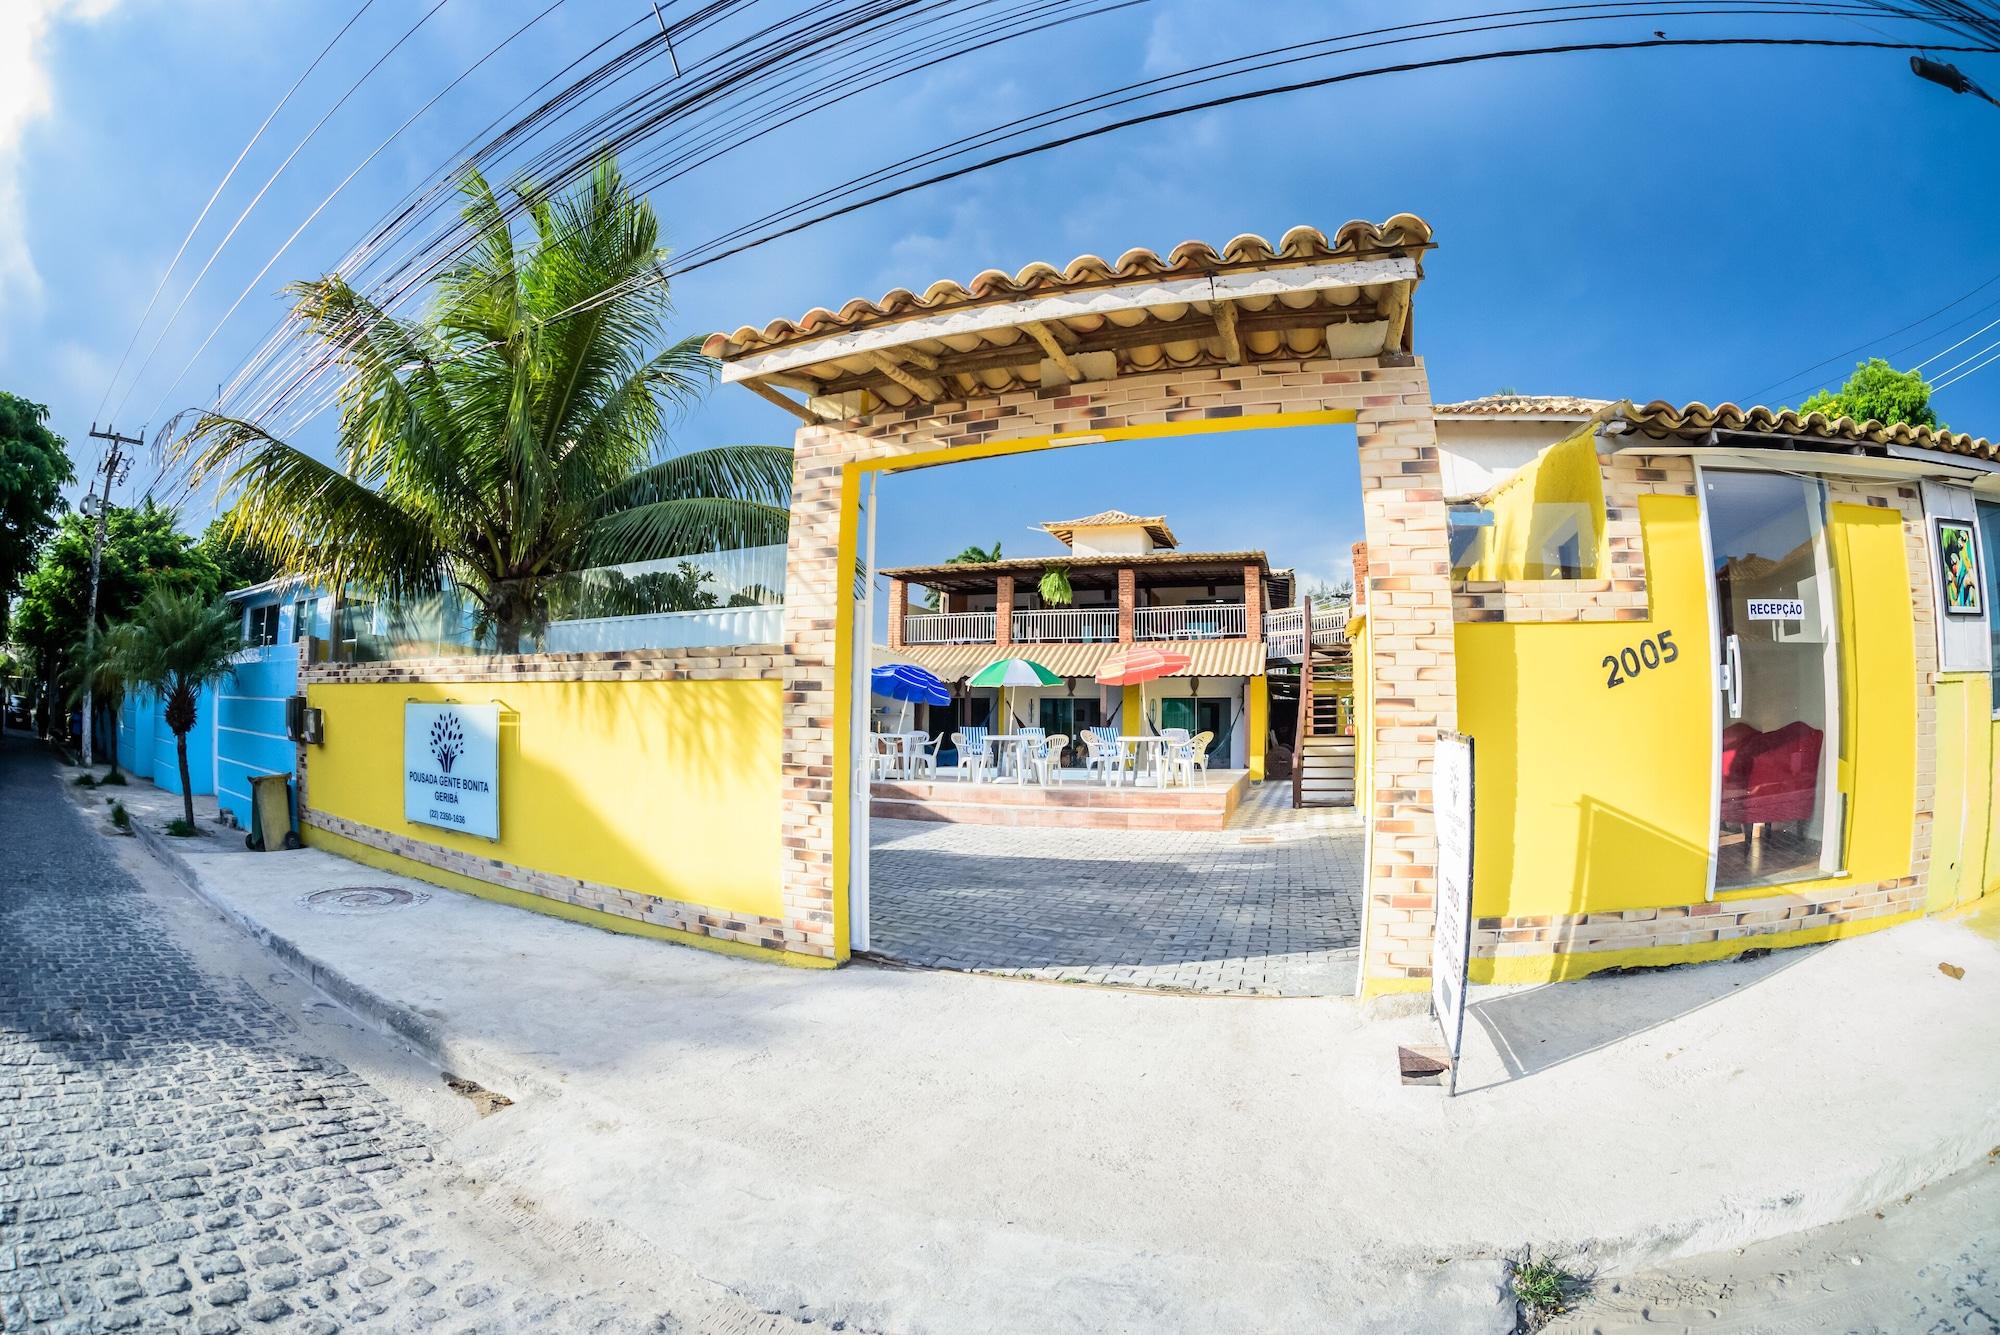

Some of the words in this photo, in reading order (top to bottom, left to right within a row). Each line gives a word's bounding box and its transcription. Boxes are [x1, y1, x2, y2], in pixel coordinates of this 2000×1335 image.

[1750, 601, 1802, 617] RECEPÇÃO
[1602, 630, 1679, 689] 2005
[409, 771, 438, 785] POUSADA
[439, 776, 461, 789] GENTE
[462, 779, 489, 793] BONITA
[434, 791, 459, 804] GERIBÁ
[429, 809, 439, 822] (22)
